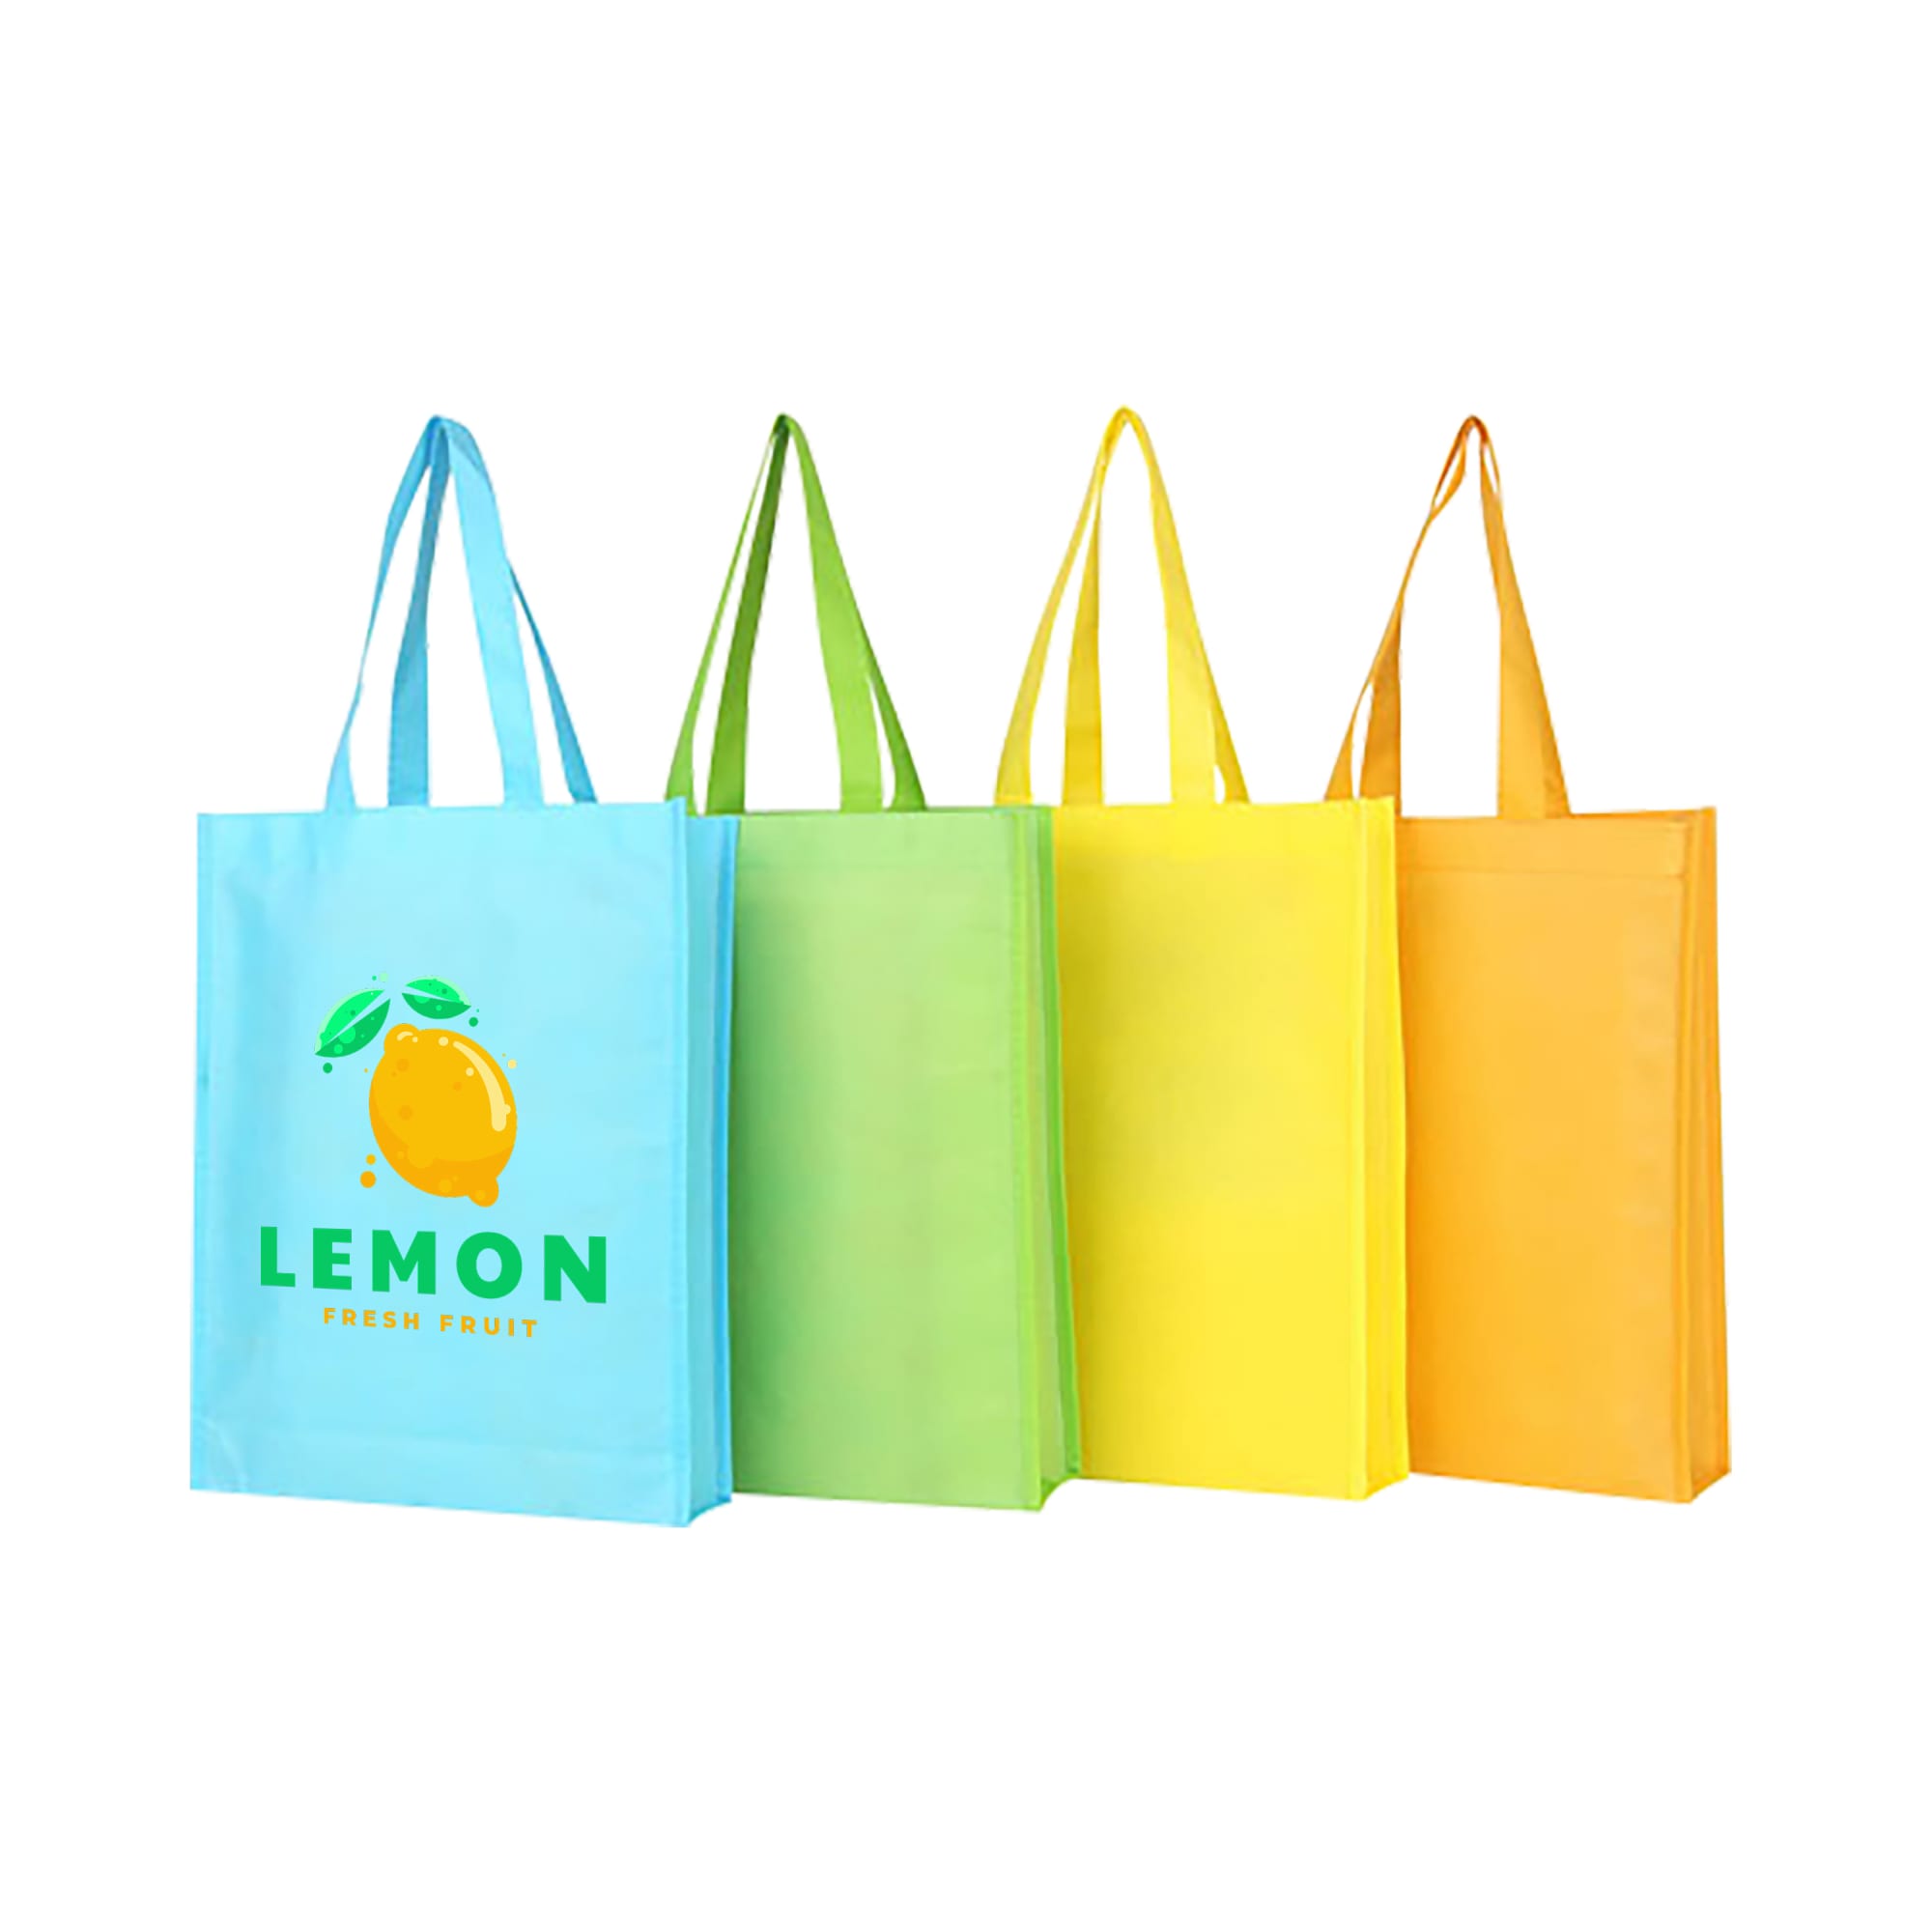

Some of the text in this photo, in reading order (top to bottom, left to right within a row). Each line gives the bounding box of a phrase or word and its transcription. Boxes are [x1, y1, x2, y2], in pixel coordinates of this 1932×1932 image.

[261, 1226, 607, 1304] LEMON
[323, 1307, 538, 1338] FRESH FRUIT
